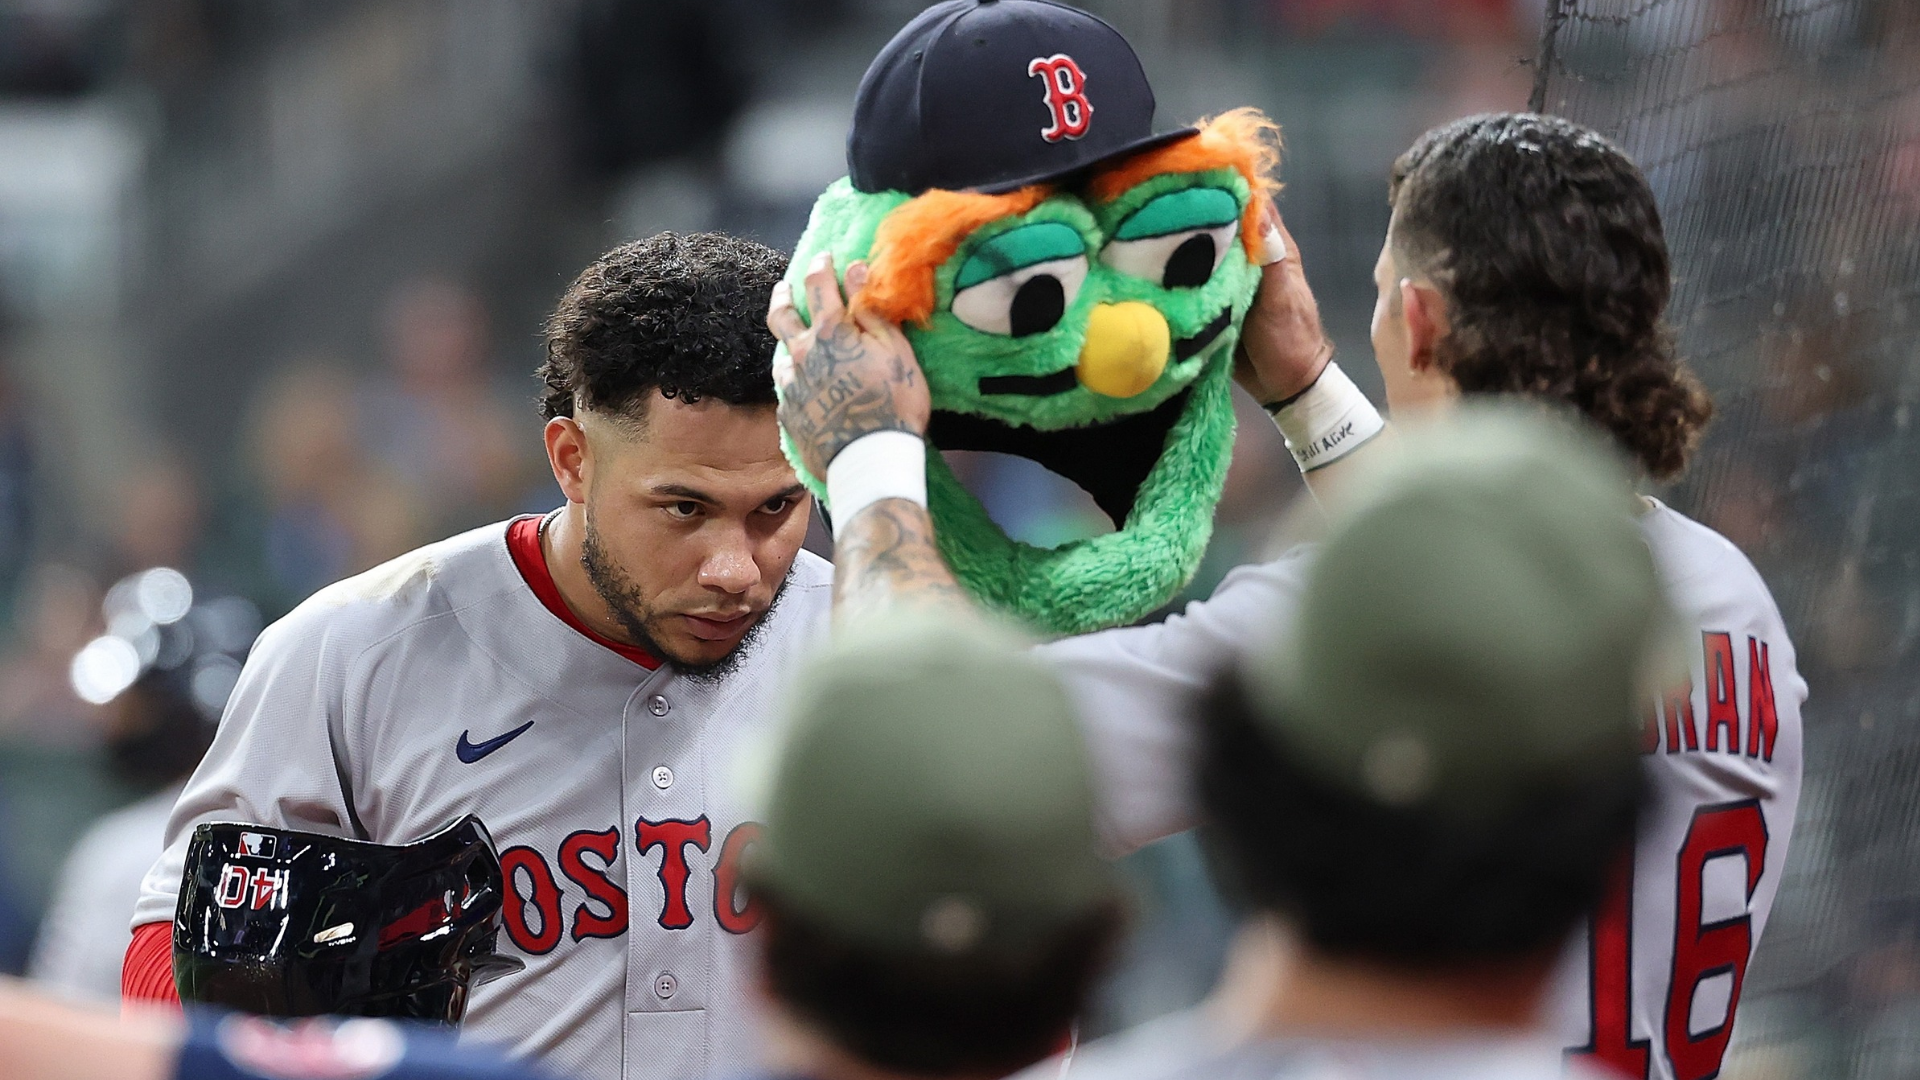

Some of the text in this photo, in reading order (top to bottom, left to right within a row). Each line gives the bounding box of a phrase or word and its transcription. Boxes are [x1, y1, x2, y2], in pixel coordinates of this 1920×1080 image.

[1028, 53, 1094, 142] B
[1638, 630, 1779, 763] RAN
[499, 813, 772, 956] OSTO
[1562, 796, 1769, 1080] 16
